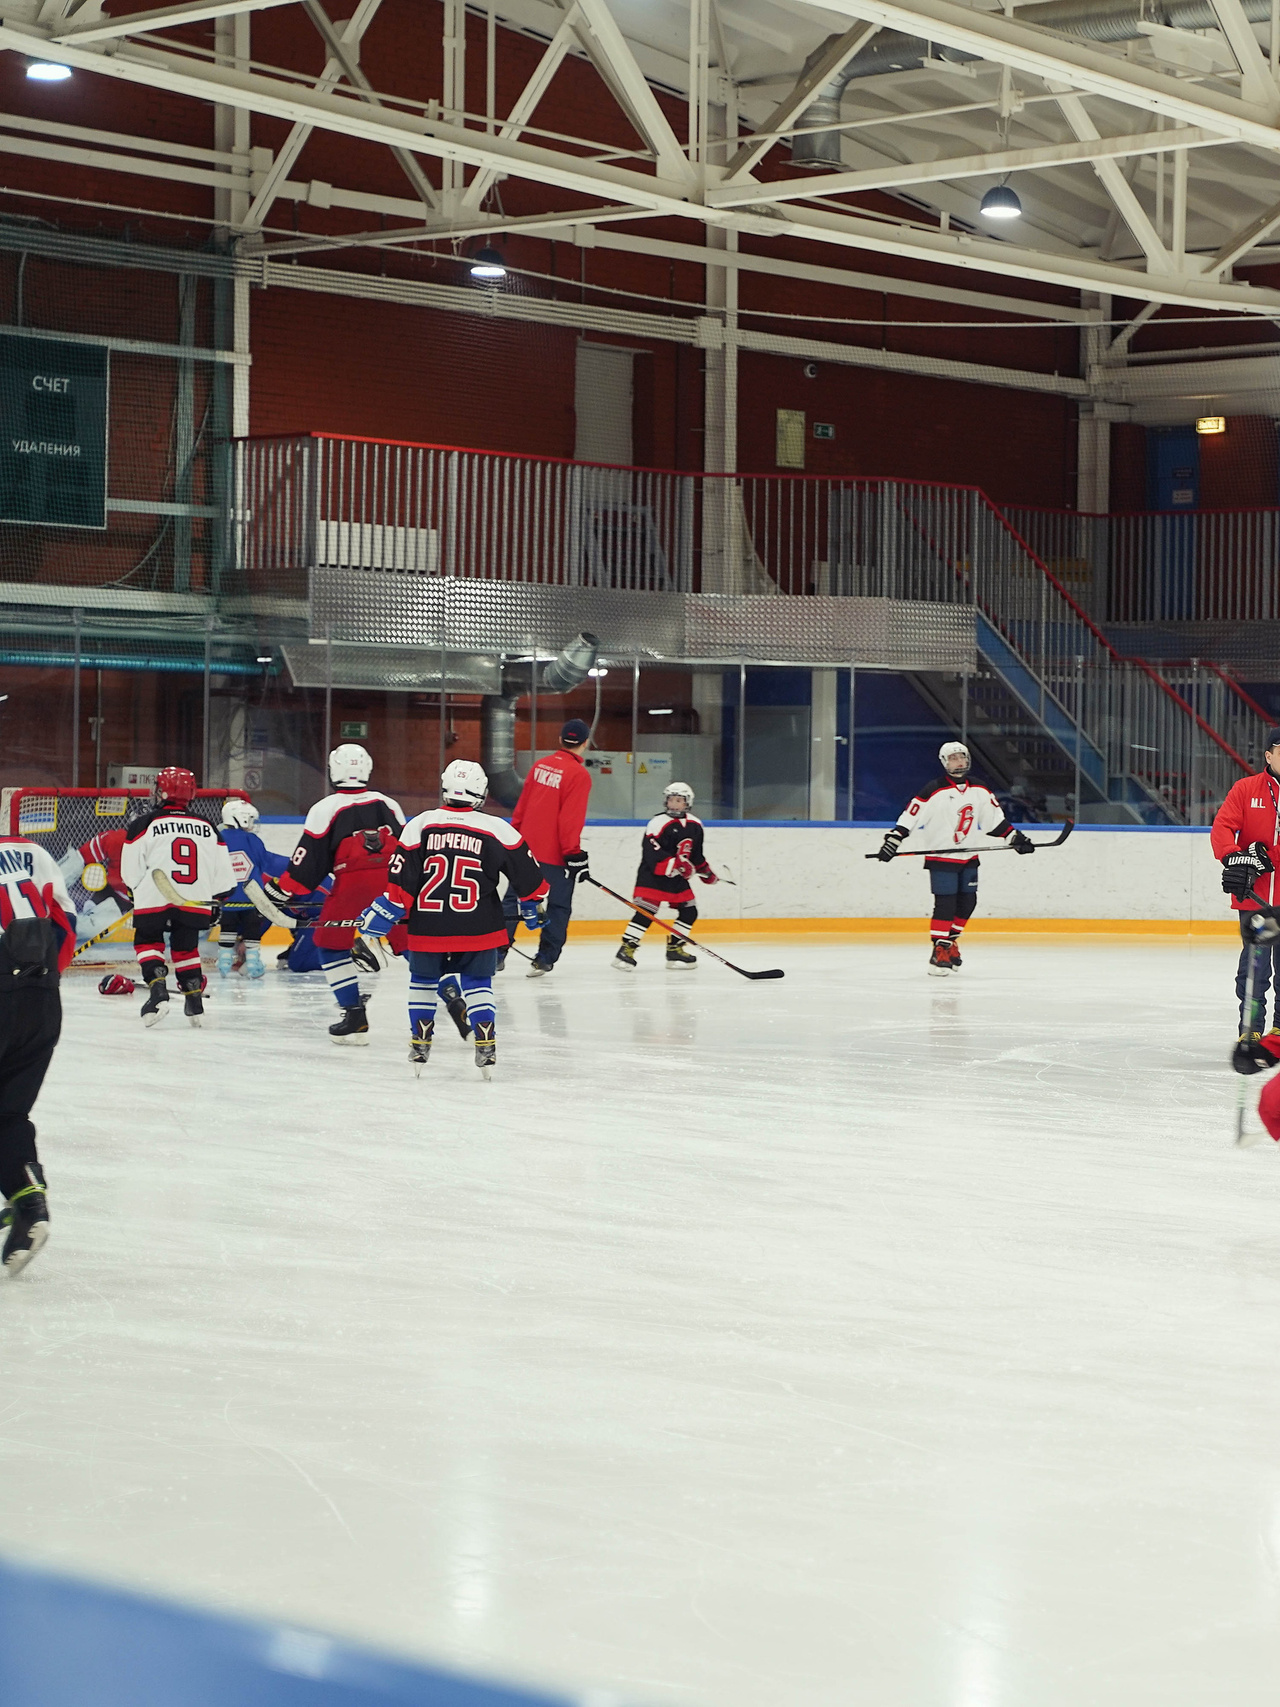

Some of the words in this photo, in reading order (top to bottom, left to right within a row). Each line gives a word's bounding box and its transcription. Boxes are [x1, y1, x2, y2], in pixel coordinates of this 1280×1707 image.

[32, 375, 70, 394] СЧЕТ
[12, 439, 81, 457] УДАЛЕНИЯ
[534, 767, 562, 789] VIKHR
[1250, 798, 1266, 809] M.L.
[152, 822, 212, 838] АНТИПОВ
[171, 837, 198, 885] 9
[416, 853, 484, 913] 25
